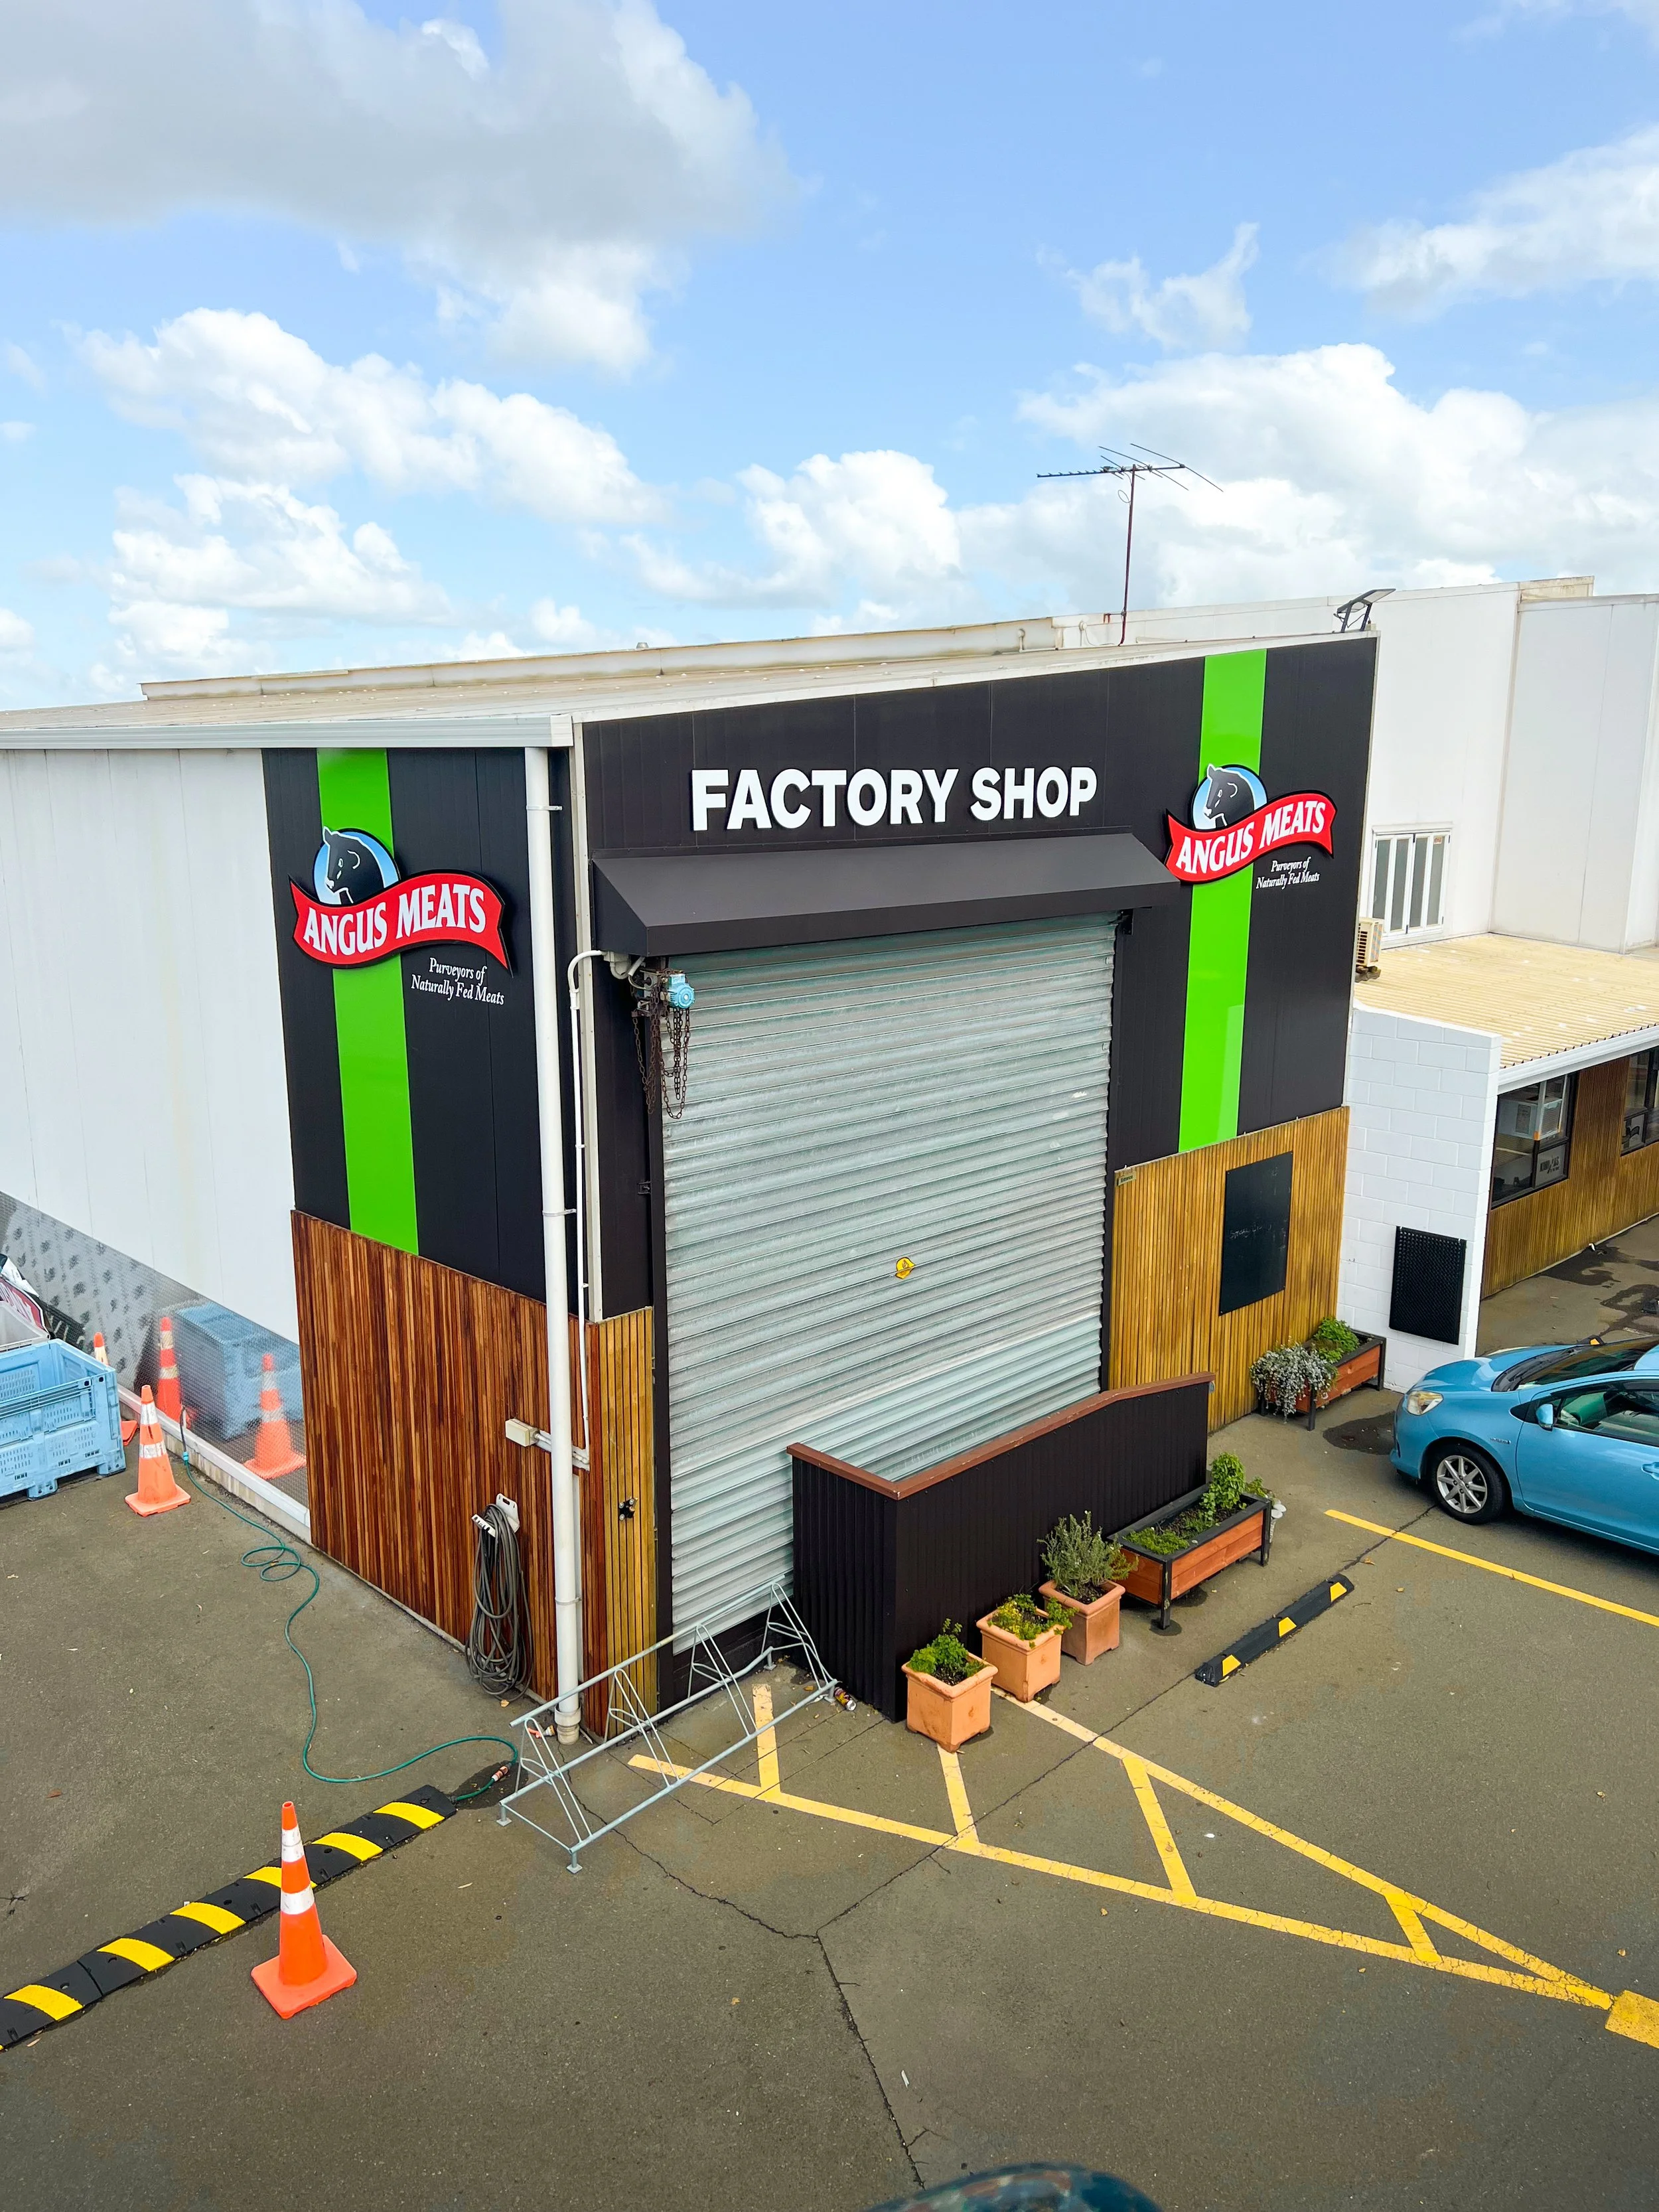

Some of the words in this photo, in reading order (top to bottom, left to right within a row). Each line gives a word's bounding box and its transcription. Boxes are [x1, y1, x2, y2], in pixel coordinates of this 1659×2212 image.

[691, 769, 959, 831] FACTORY
[970, 766, 1098, 822] SHOP
[1175, 821, 1255, 874] ANGUS
[1258, 800, 1326, 849] MEATS
[1256, 873, 1287, 890] Naturally
[1287, 872, 1301, 885] Fed
[1301, 871, 1320, 883] Meats
[1270, 860, 1302, 874] Purveyors
[1303, 856, 1312, 873] of
[303, 901, 388, 956] ANGUS
[396, 883, 486, 939] MEATS
[429, 957, 474, 982] Purveyors
[475, 966, 488, 986] of
[411, 974, 455, 1001] Naturally
[455, 982, 474, 999] Fed
[474, 985, 505, 1005] Meats
